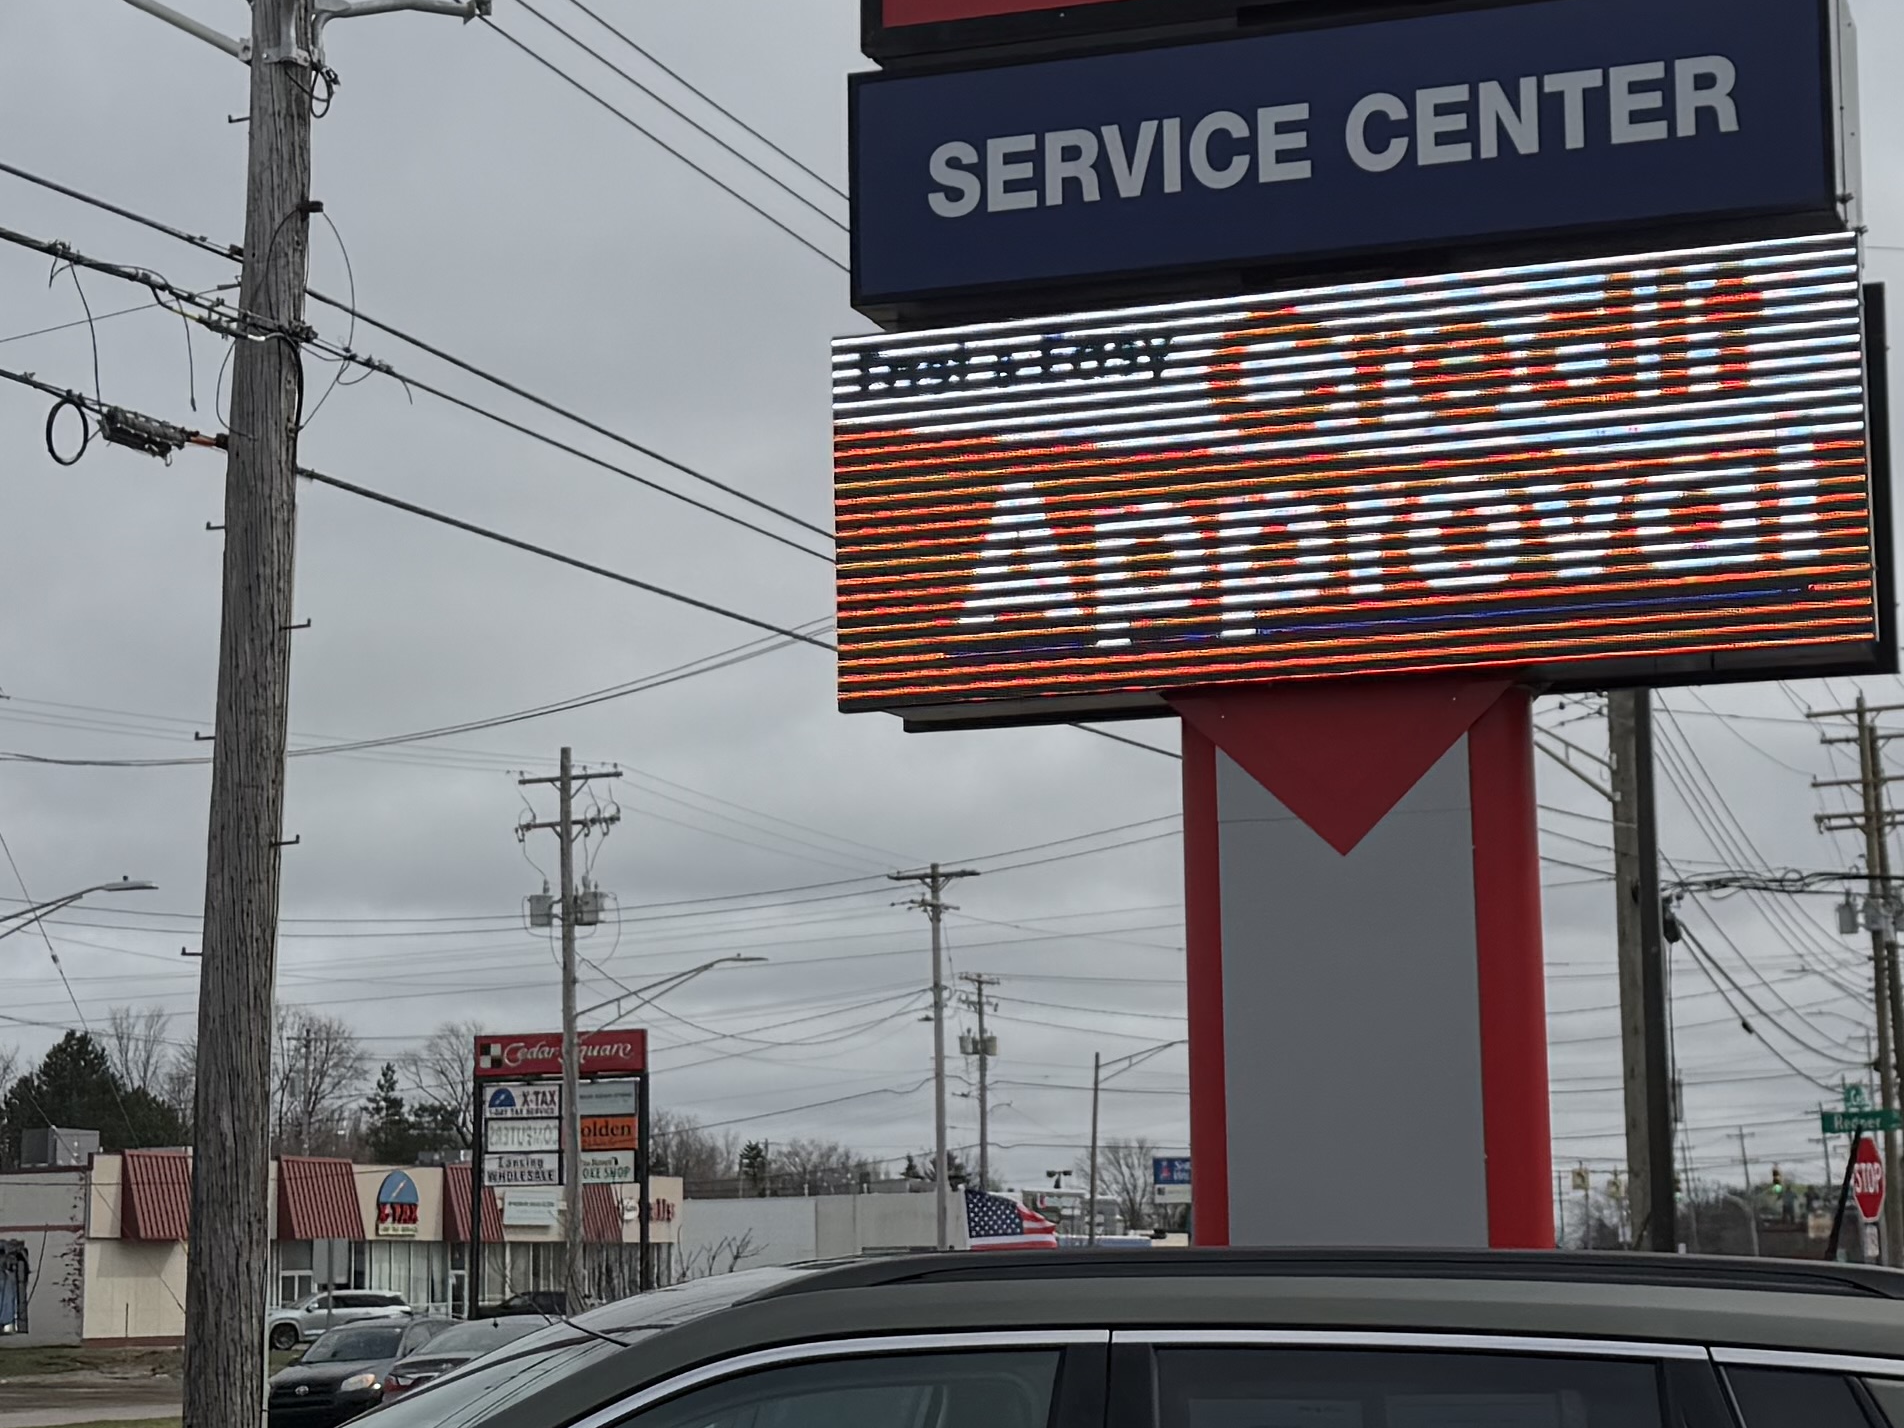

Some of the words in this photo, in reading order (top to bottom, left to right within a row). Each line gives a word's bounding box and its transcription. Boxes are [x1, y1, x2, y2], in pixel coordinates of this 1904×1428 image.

[927, 102, 1312, 217] SERVICE
[1345, 54, 1741, 171] CENTER
[1206, 260, 1768, 438] Credit
[957, 428, 1820, 649] Approval
[504, 1041, 559, 1067] Cedar
[558, 1042, 631, 1064] quare
[581, 1119, 632, 1137] olden
[1853, 1162, 1882, 1193] STOP
